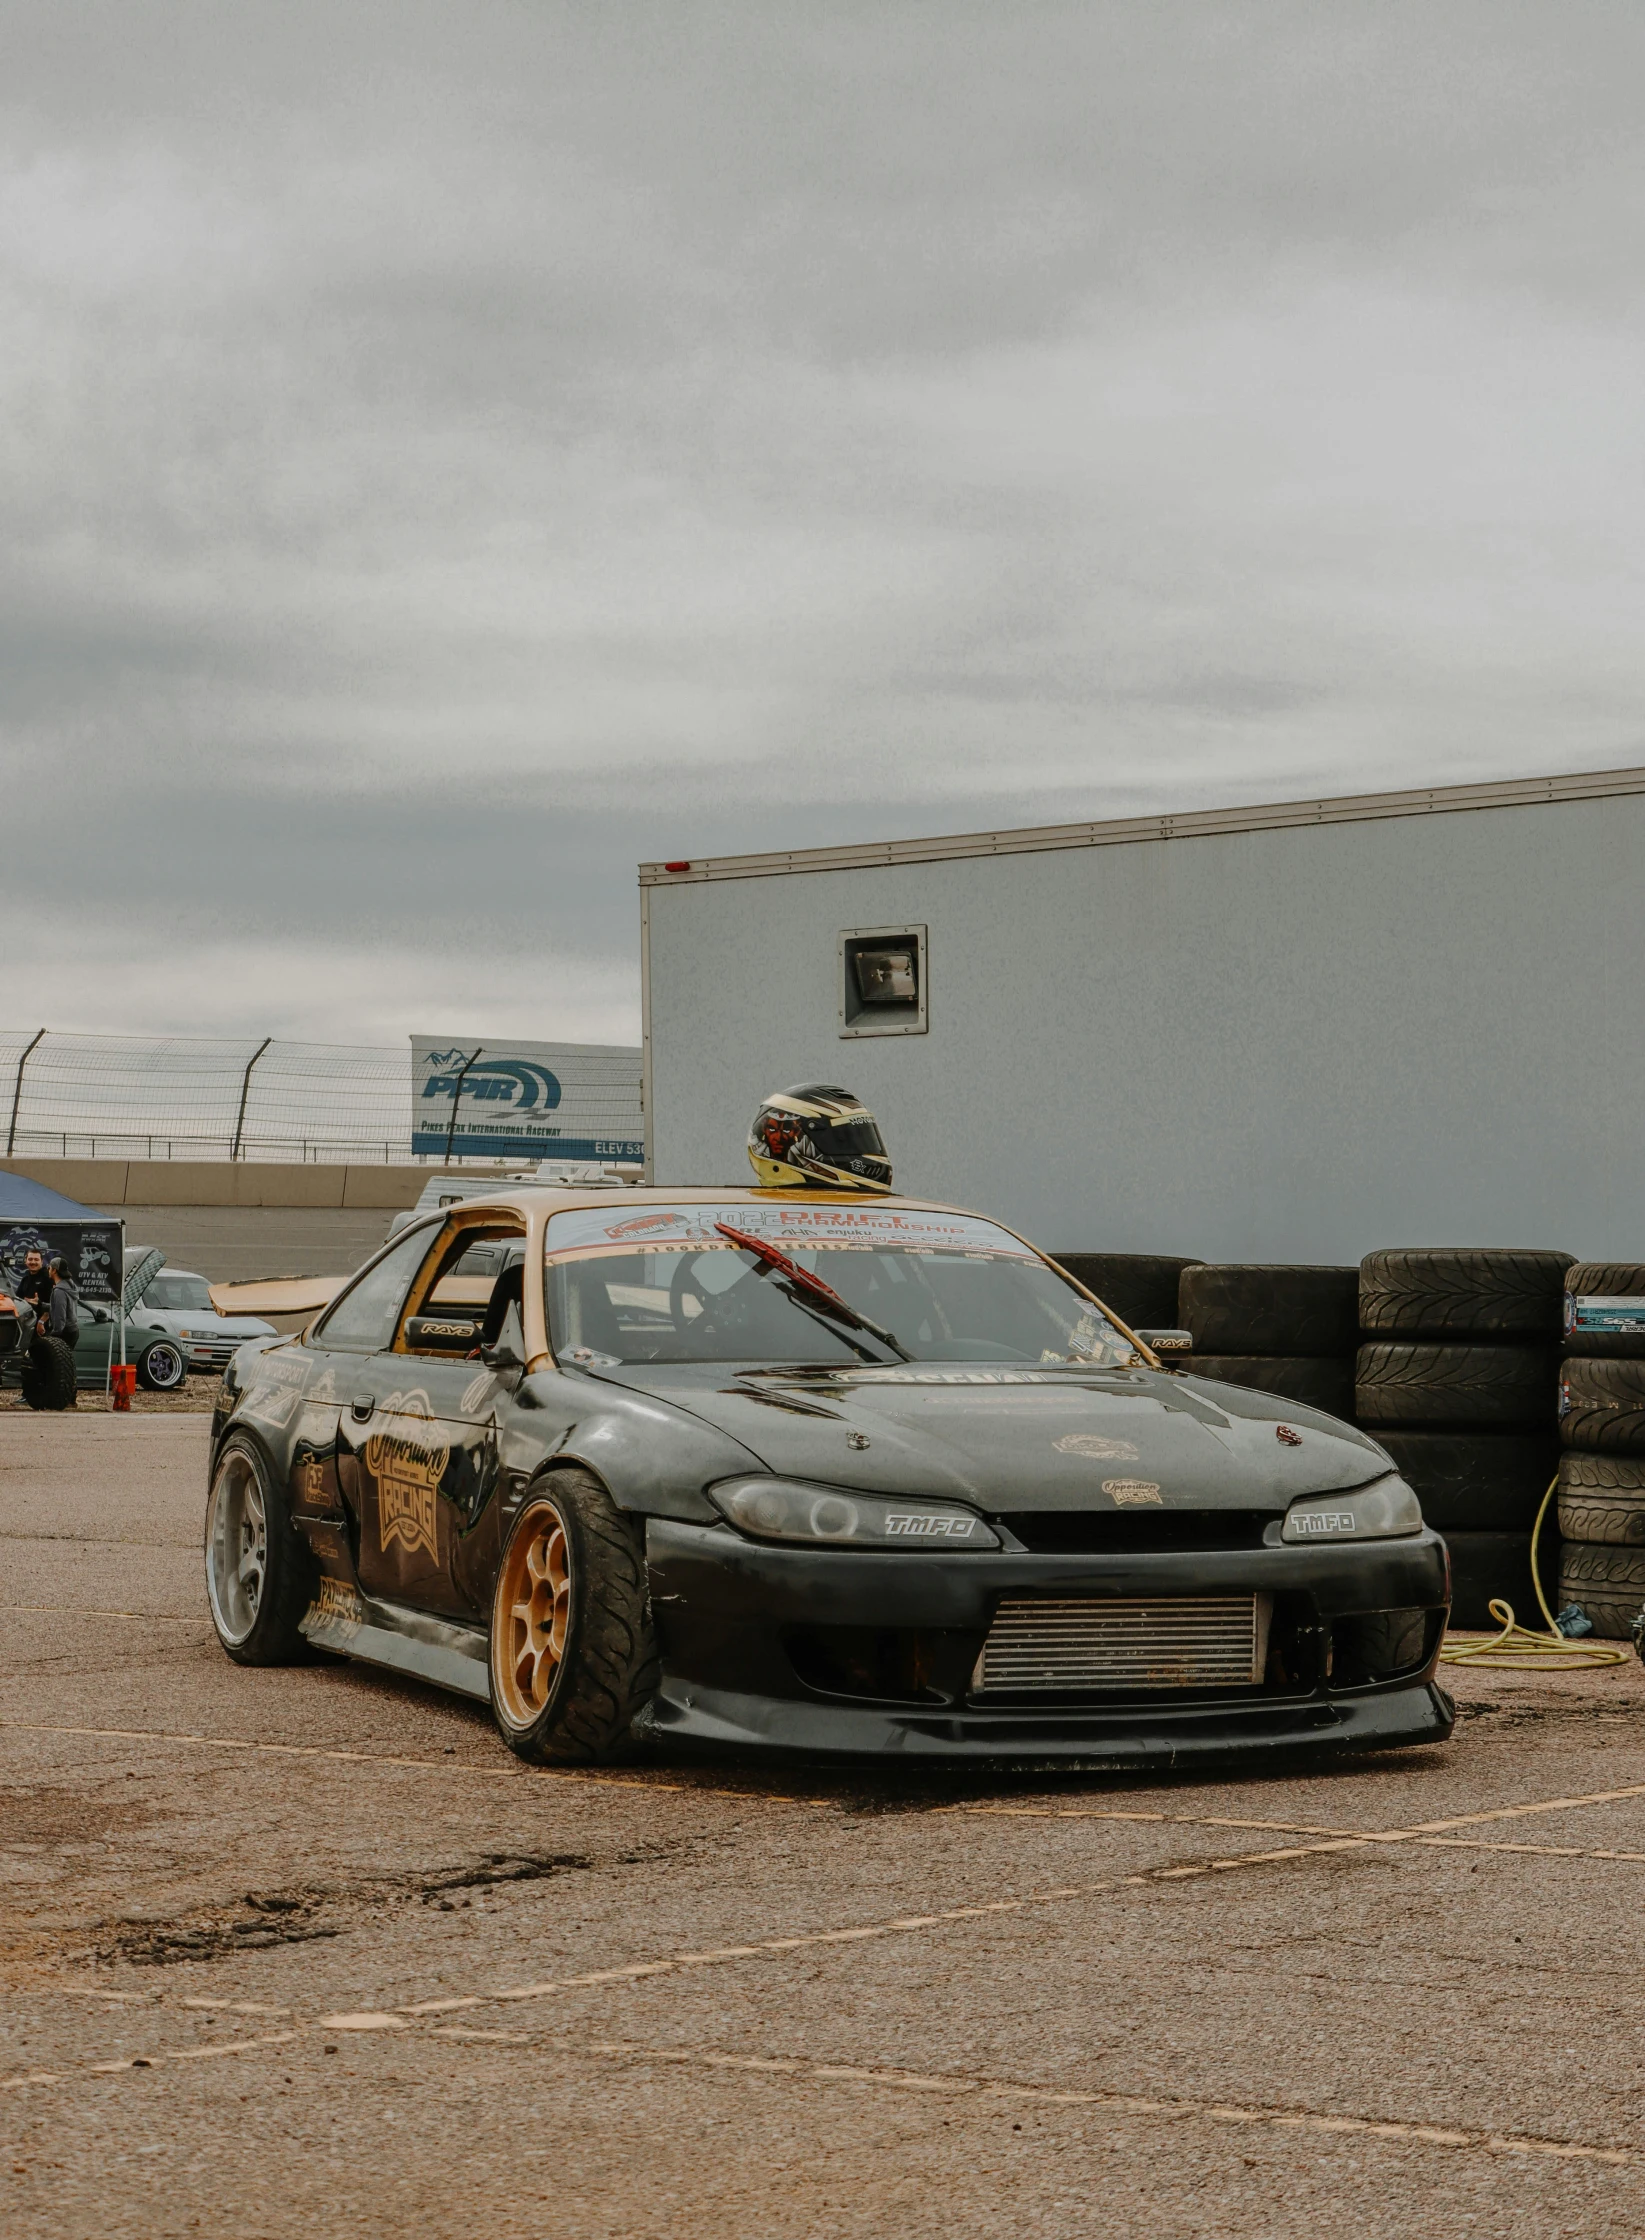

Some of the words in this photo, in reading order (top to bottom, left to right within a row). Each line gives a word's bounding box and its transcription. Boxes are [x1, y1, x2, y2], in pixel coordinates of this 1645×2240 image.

[421, 1076, 519, 1100] PPIR
[421, 1121, 444, 1132] PIKES
[468, 1122, 524, 1135] INTERNATIONAL
[526, 1124, 562, 1137] RACEWAY
[595, 1142, 623, 1154] ELEV
[698, 1211, 781, 1226] 2022
[780, 1211, 908, 1223] DRIFT
[623, 1224, 665, 1239] COLORADO
[781, 1218, 966, 1234] CHAMPIONSHIP
[827, 1229, 872, 1237] enjuku
[849, 1235, 887, 1243] racing
[421, 1323, 474, 1337] RAYS
[1151, 1338, 1192, 1349] RAYS
[1104, 1482, 1157, 1492] Opposition
[1117, 1491, 1157, 1500] RACING
[383, 1480, 433, 1528] RACING
